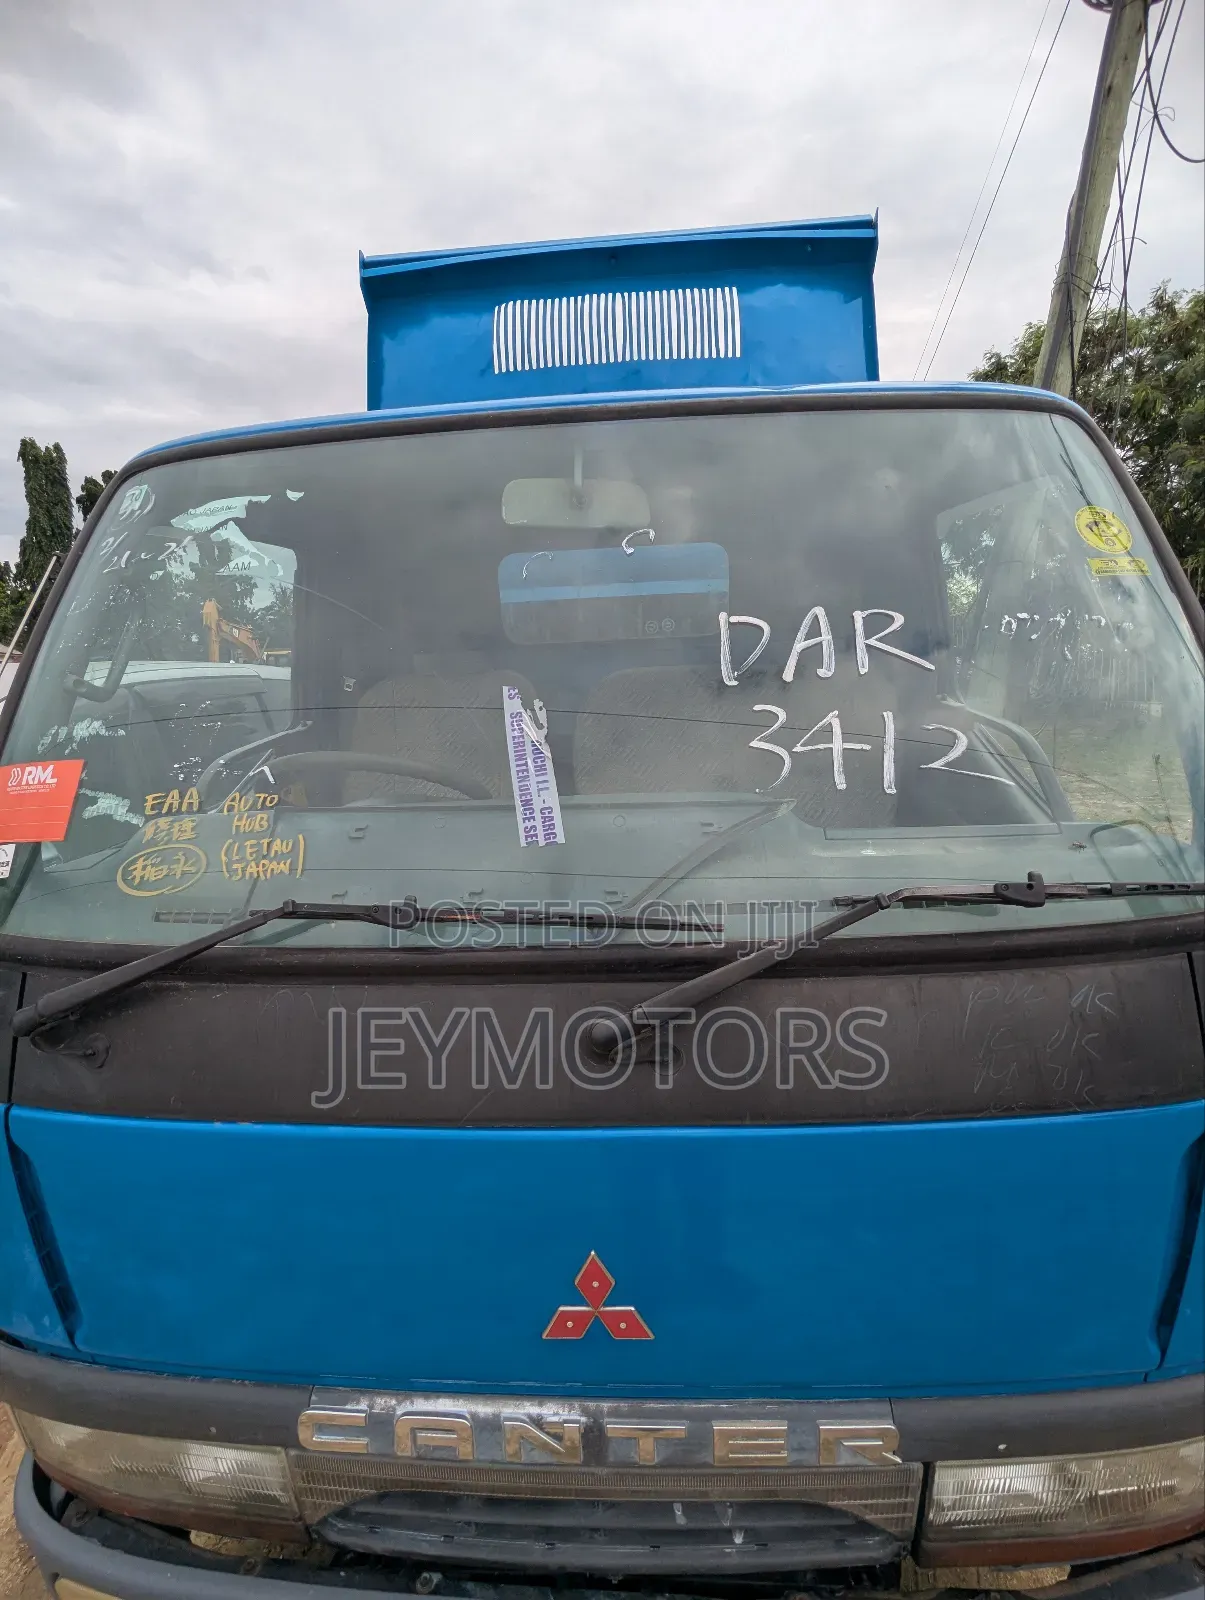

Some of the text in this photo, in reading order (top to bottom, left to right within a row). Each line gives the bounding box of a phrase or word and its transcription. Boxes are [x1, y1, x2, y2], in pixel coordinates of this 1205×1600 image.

[719, 606, 936, 686] DAR
[509, 711, 536, 822] SUPERINTENDENCE
[749, 704, 1016, 795] 3412
[223, 792, 279, 815] AUTO
[297, 1404, 903, 1466] CANTER
